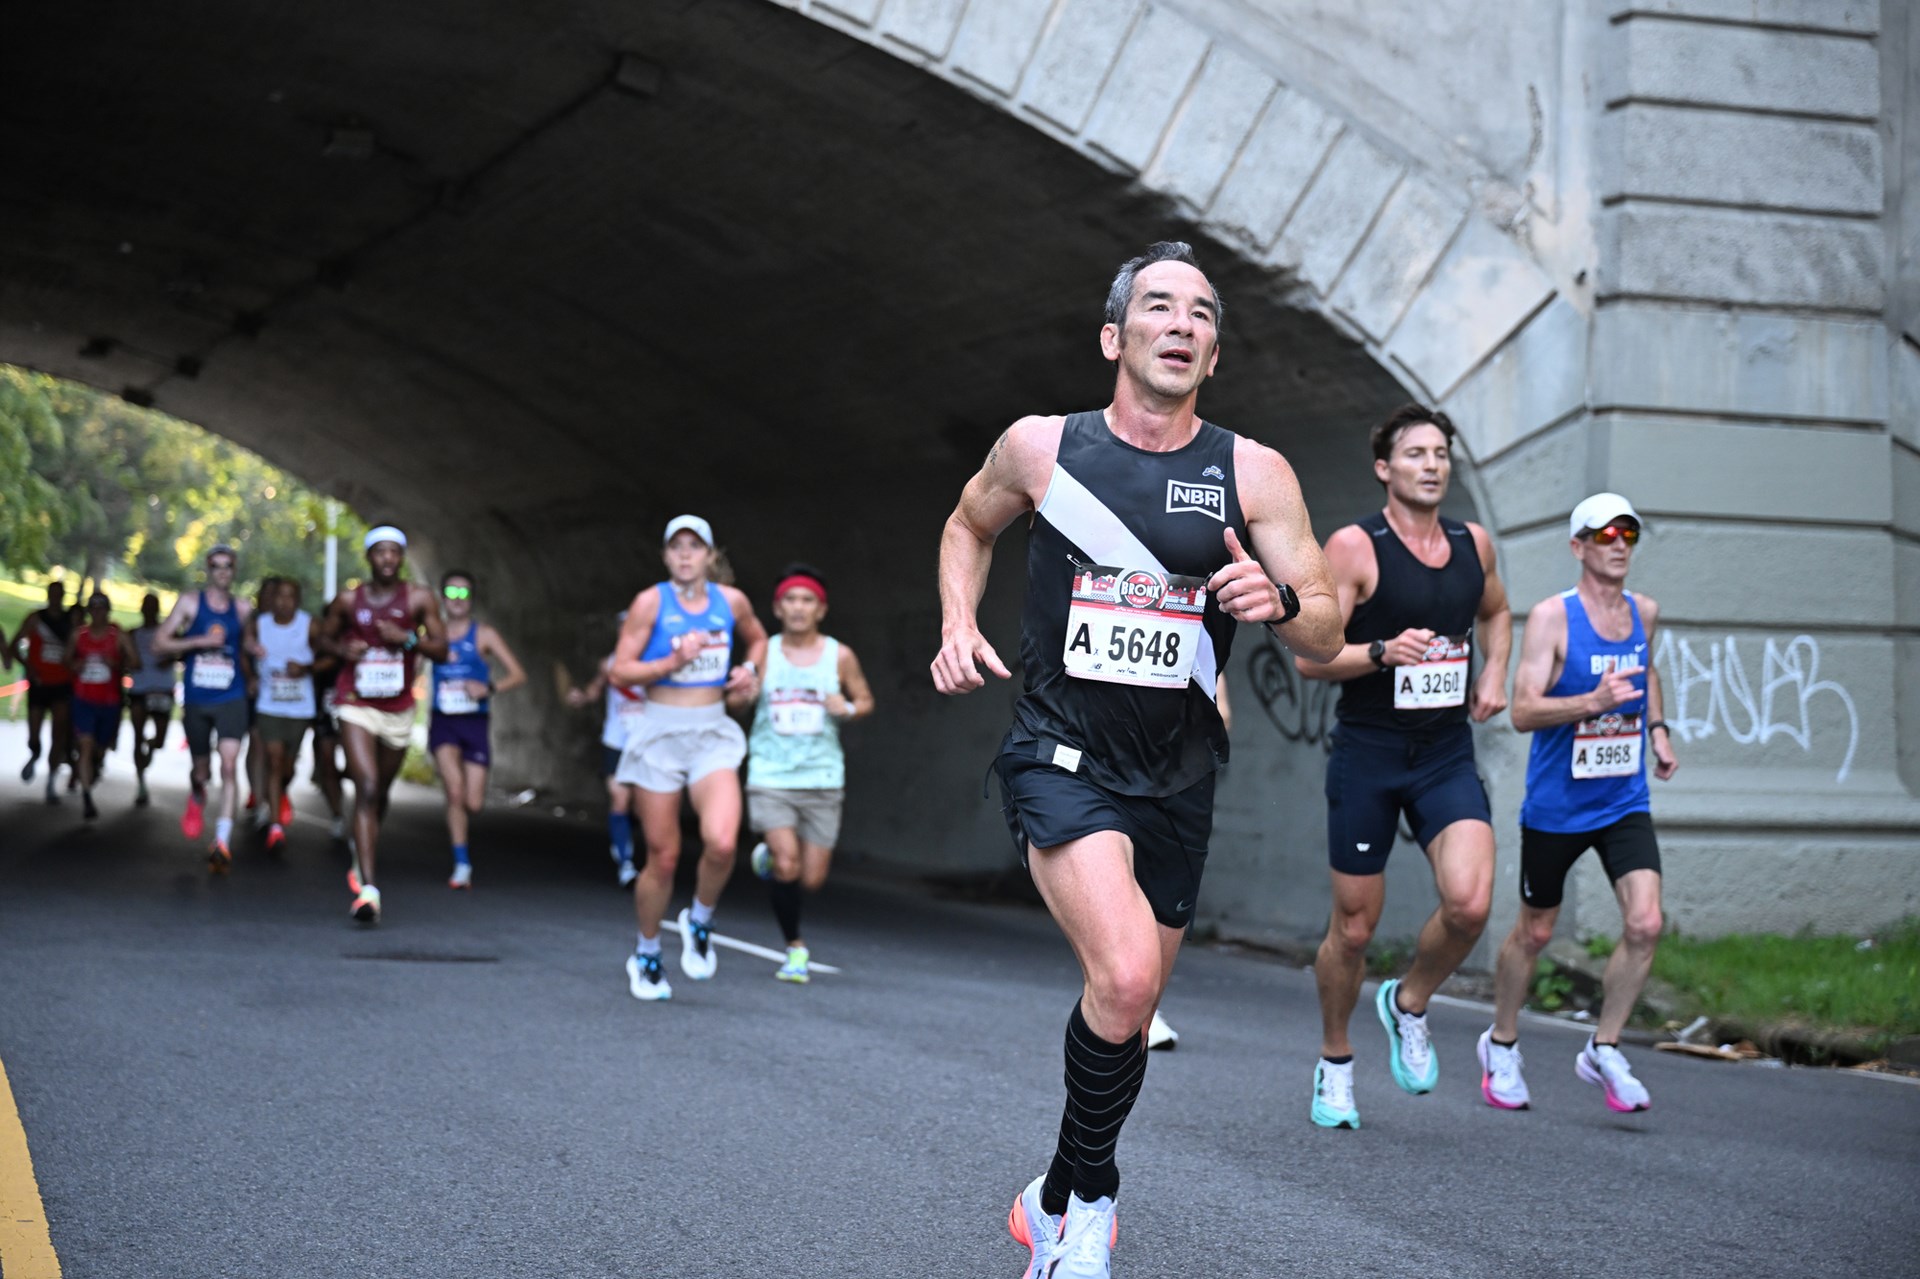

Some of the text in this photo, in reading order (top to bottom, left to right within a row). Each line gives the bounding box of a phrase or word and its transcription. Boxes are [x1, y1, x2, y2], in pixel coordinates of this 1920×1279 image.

[1173, 486, 1220, 508] NBR
[1120, 580, 1161, 600] BRONX
[1069, 622, 1091, 654] A
[1108, 625, 1181, 668] 5648
[1400, 671, 1459, 695] A 3260
[1576, 744, 1631, 766] A 5968
